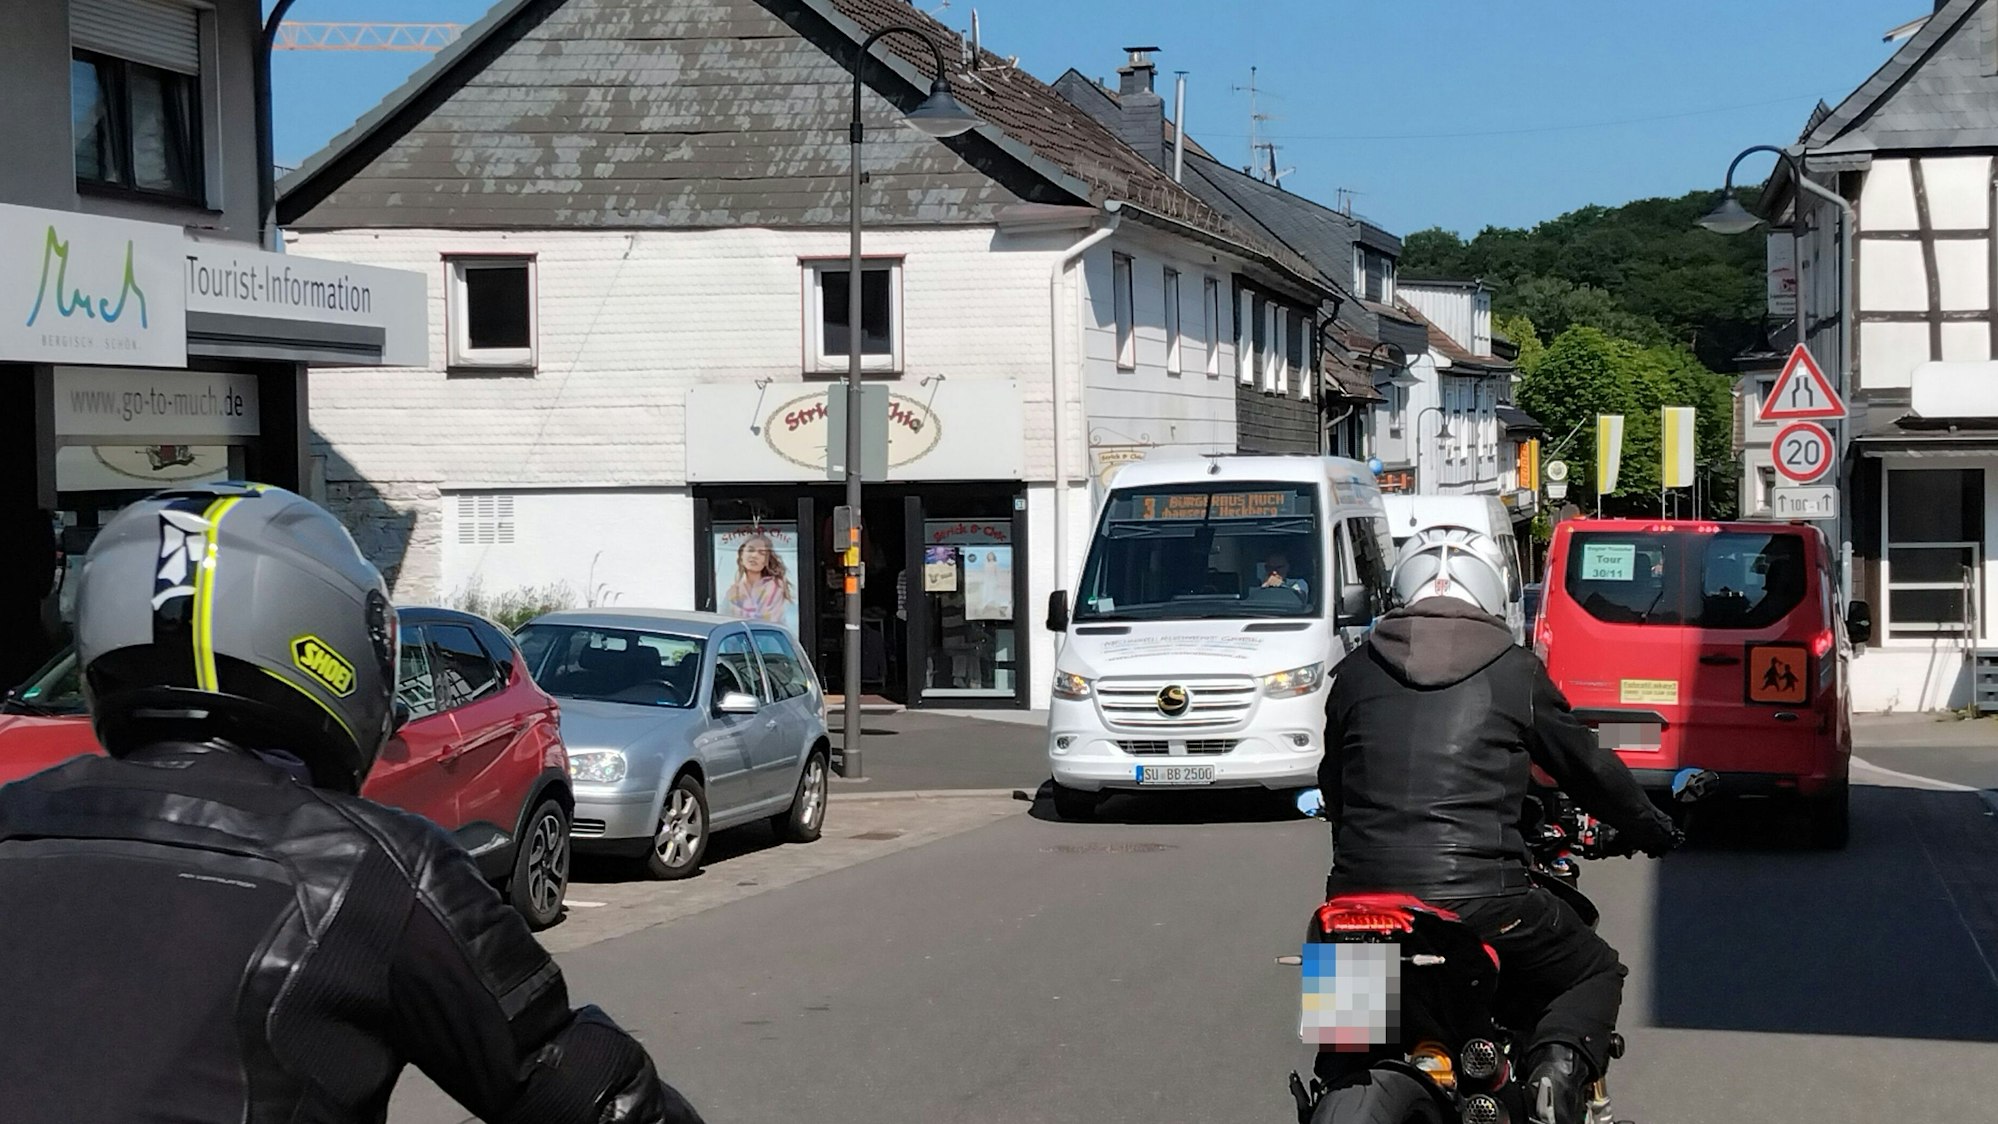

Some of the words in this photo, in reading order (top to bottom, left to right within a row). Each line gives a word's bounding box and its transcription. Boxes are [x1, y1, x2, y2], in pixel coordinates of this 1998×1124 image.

[186, 255, 373, 315] Tourist-Information
[70, 385, 244, 422] www.go-to-much.de
[1786, 438, 1822, 466] 20
[1144, 496, 1156, 519] 3
[1248, 493, 1285, 507] MUCH
[1596, 554, 1623, 564] Tour
[301, 642, 353, 692] SHOEI
[1144, 768, 1159, 781] SU
[1167, 768, 1182, 781] BB
[1184, 767, 1213, 781] 2500
